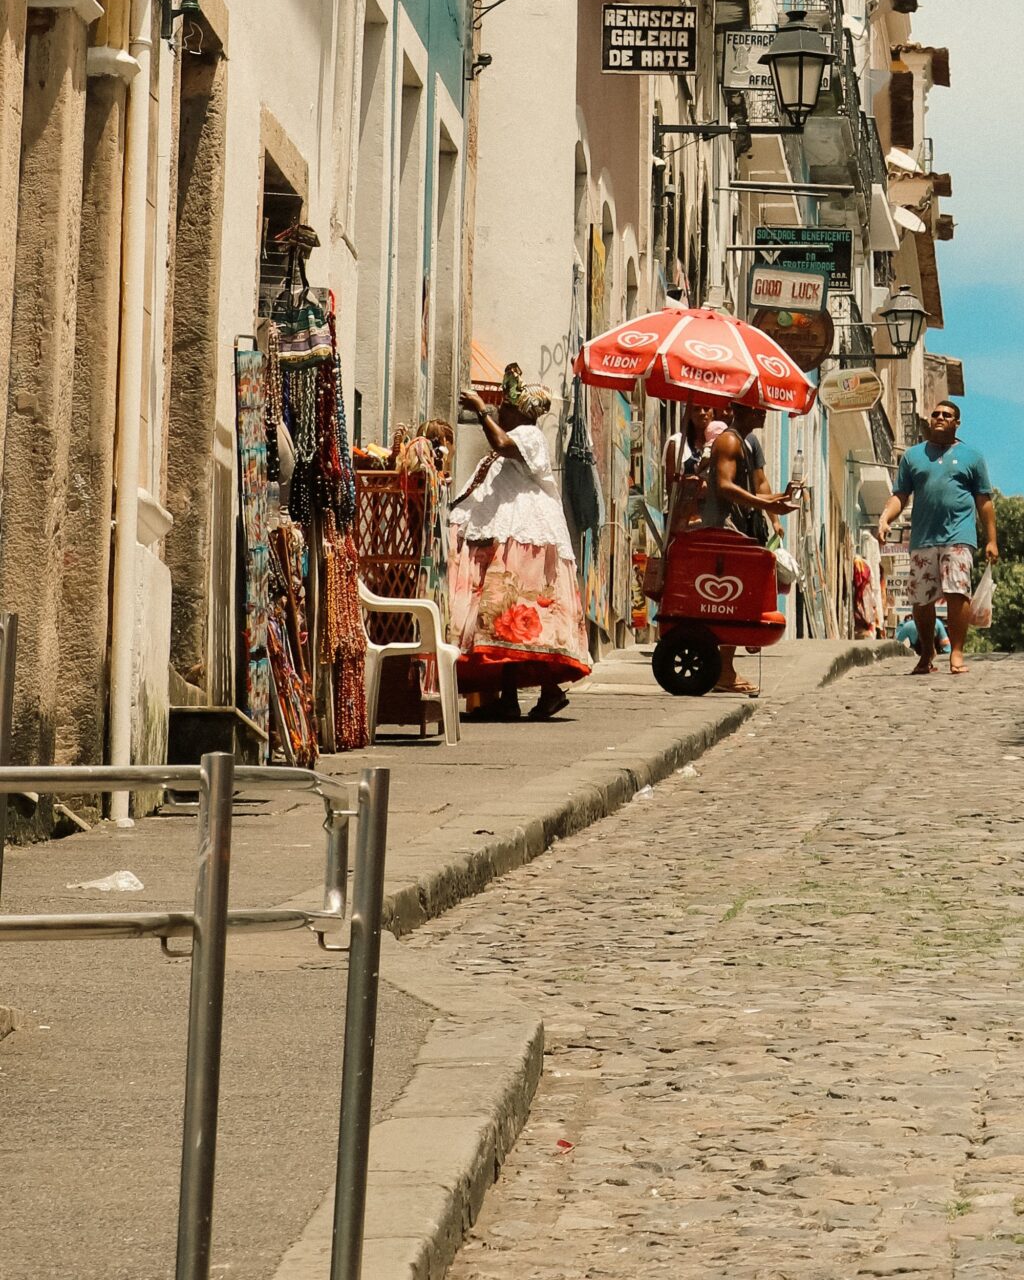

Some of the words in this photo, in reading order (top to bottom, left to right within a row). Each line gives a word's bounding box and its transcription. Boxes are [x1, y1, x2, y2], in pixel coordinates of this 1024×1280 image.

[604, 9, 695, 28] RENASCER
[611, 29, 689, 47] GALERIA
[609, 49, 633, 66] DE
[641, 50, 689, 68] ARTE
[757, 229, 797, 240] SOCIEDADE
[801, 231, 851, 242] BENEFICENTE
[805, 252, 816, 261] DA
[754, 278, 782, 297] GOOD
[791, 281, 821, 301] LUCK
[602, 355, 639, 369] KIBON
[680, 365, 726, 385] KIBON
[766, 385, 795, 402] KIBON
[700, 603, 734, 614] KIBON
